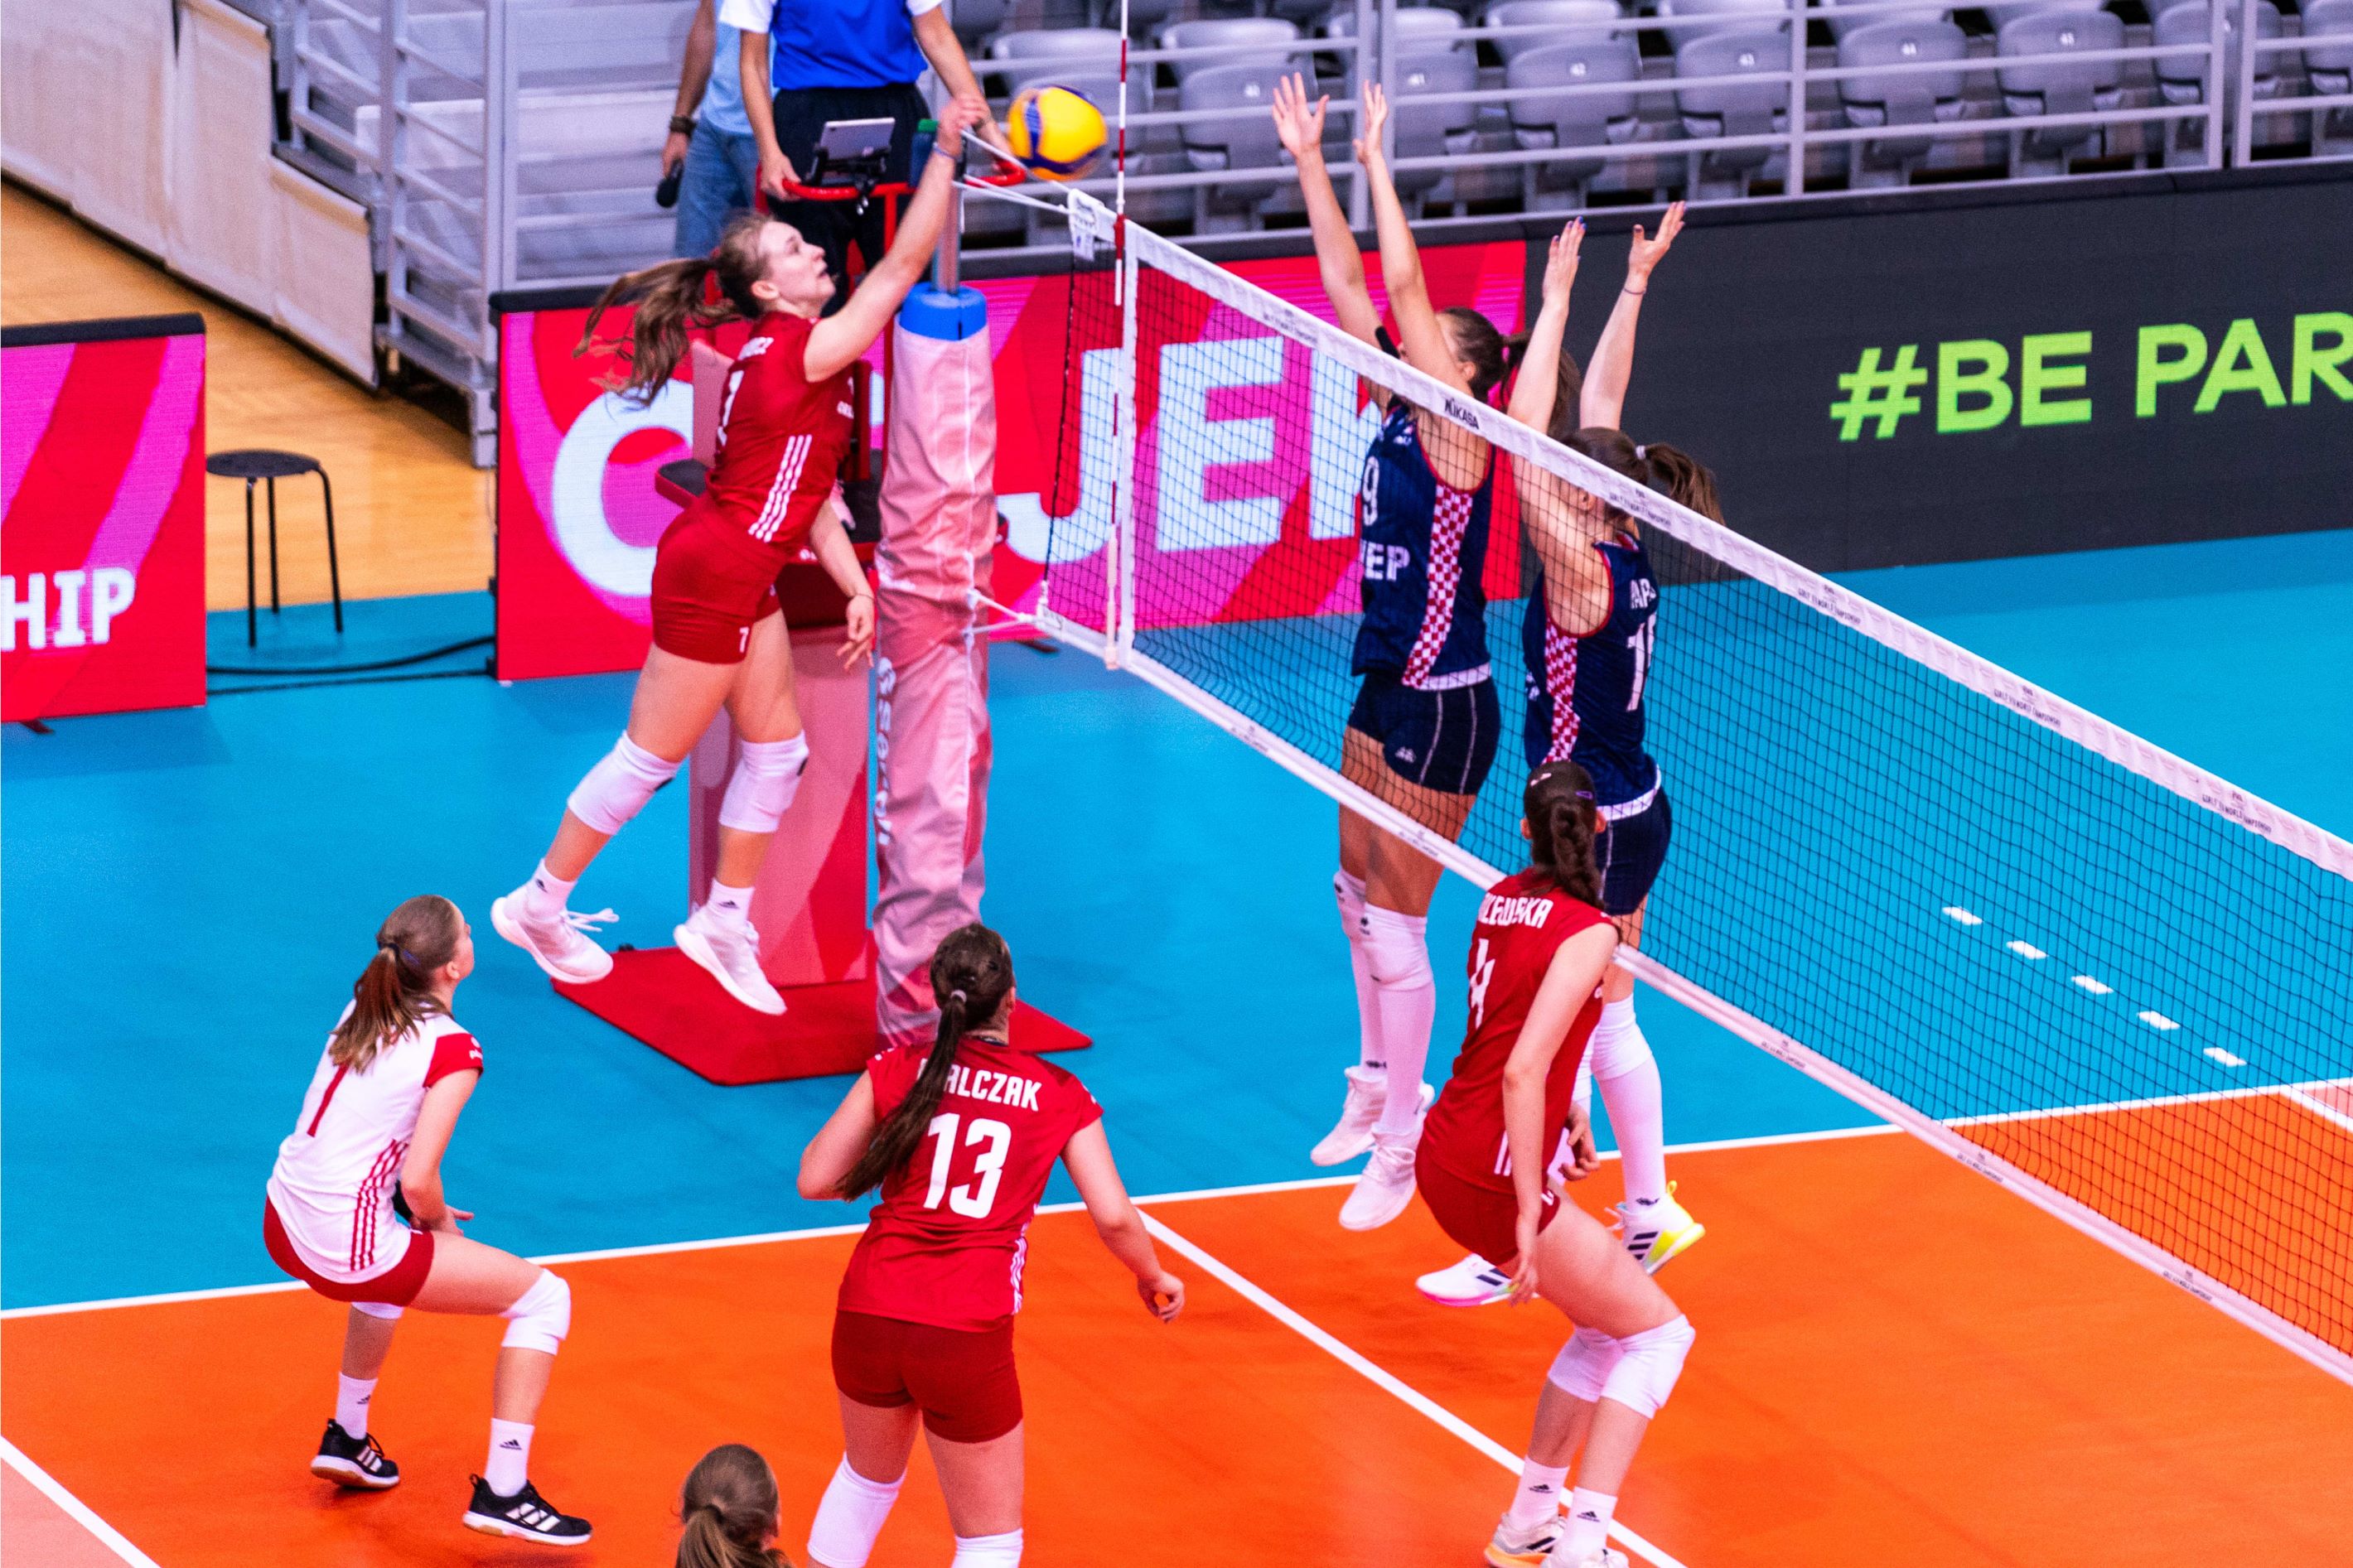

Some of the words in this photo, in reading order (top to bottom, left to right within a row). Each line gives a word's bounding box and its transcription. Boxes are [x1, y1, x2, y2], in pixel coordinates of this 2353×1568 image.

[1444, 397, 1480, 430] MIKASA
[1829, 330, 2093, 442] #BE
[2135, 311, 2353, 418] PAR
[0, 567, 137, 652] HIP
[1470, 938, 1495, 1030] 4
[917, 1058, 1041, 1112] ALCZAK
[923, 1112, 1012, 1218] 13
